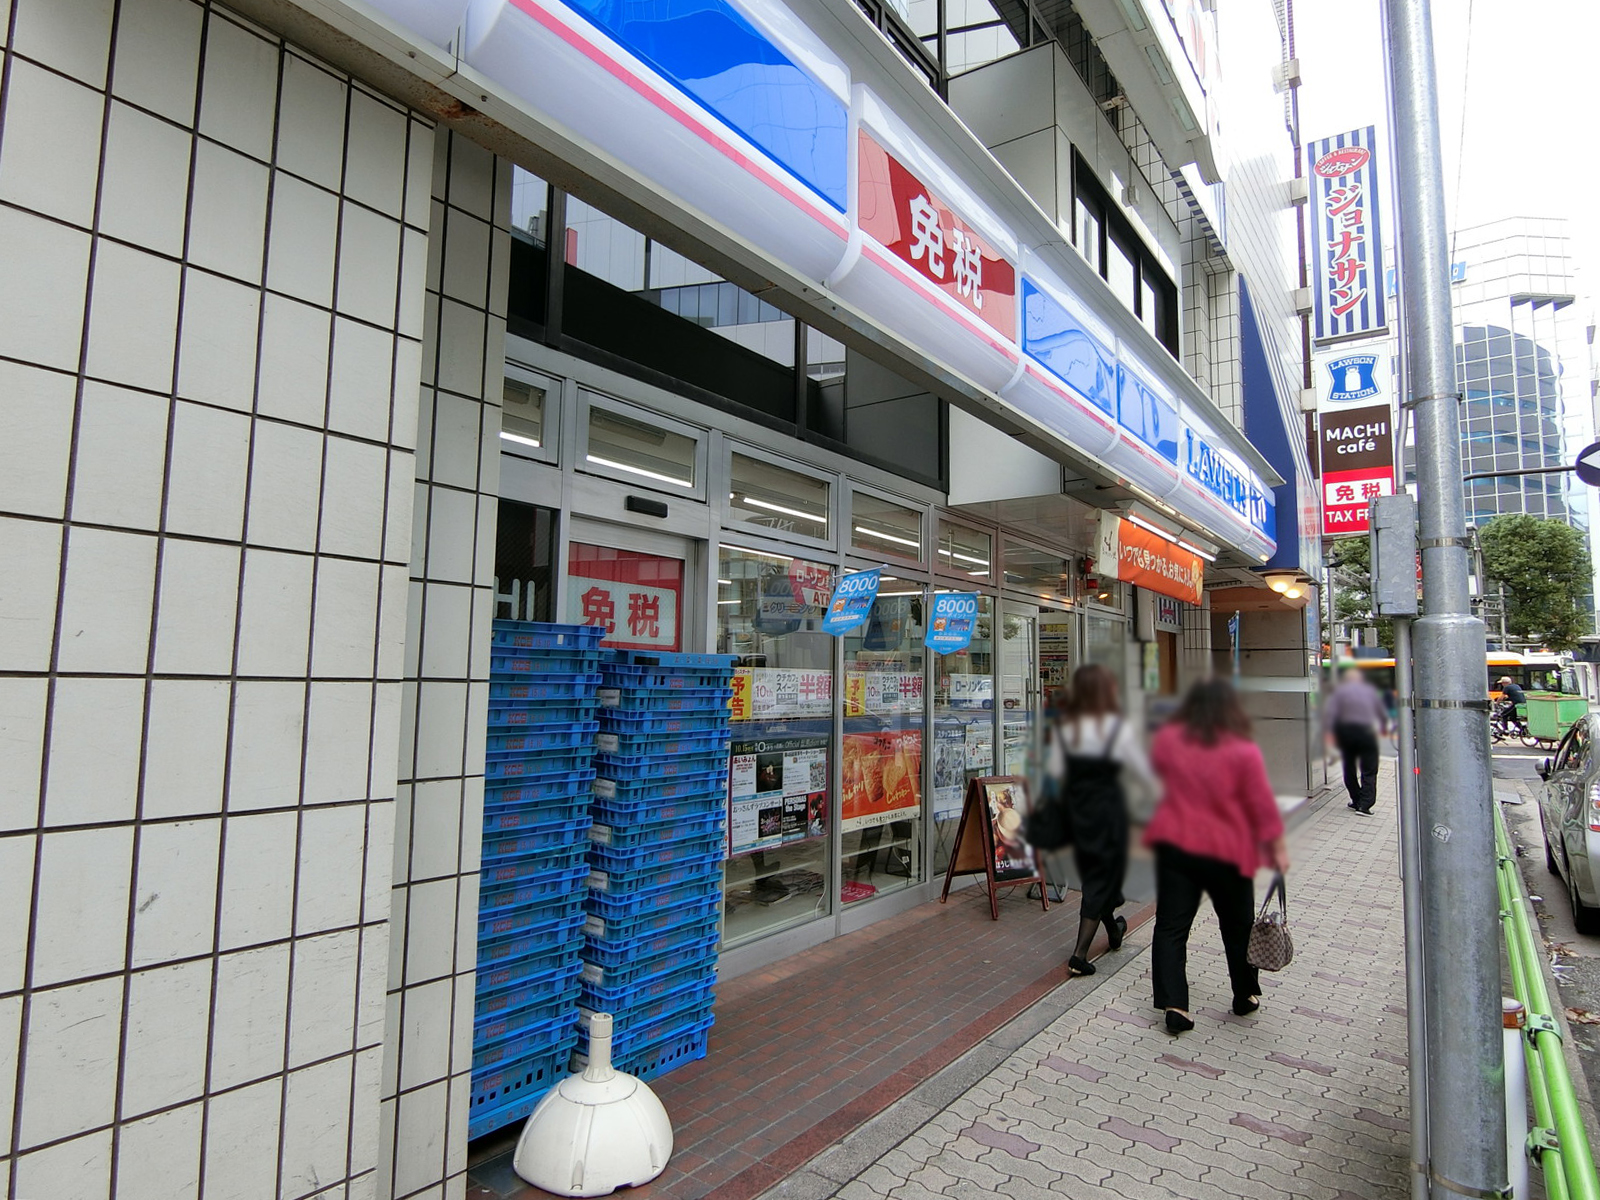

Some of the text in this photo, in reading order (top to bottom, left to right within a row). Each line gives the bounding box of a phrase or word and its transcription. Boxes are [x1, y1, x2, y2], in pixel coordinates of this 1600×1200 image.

[909, 193, 983, 310] 免税
[1326, 184, 1366, 317] ジョナサン
[1330, 357, 1375, 371] LAWSON
[1331, 386, 1376, 400] STATION
[1326, 422, 1386, 442] MACHI
[1336, 439, 1376, 455] café
[1335, 482, 1381, 502] 免税
[1326, 510, 1353, 523] TAX
[839, 575, 878, 593] 8000
[581, 586, 660, 638] 免税
[937, 599, 976, 614] 8000
[731, 676, 746, 717] 予告
[799, 673, 832, 701] 半額
[850, 679, 860, 713] 予告
[899, 675, 923, 699] 半額
